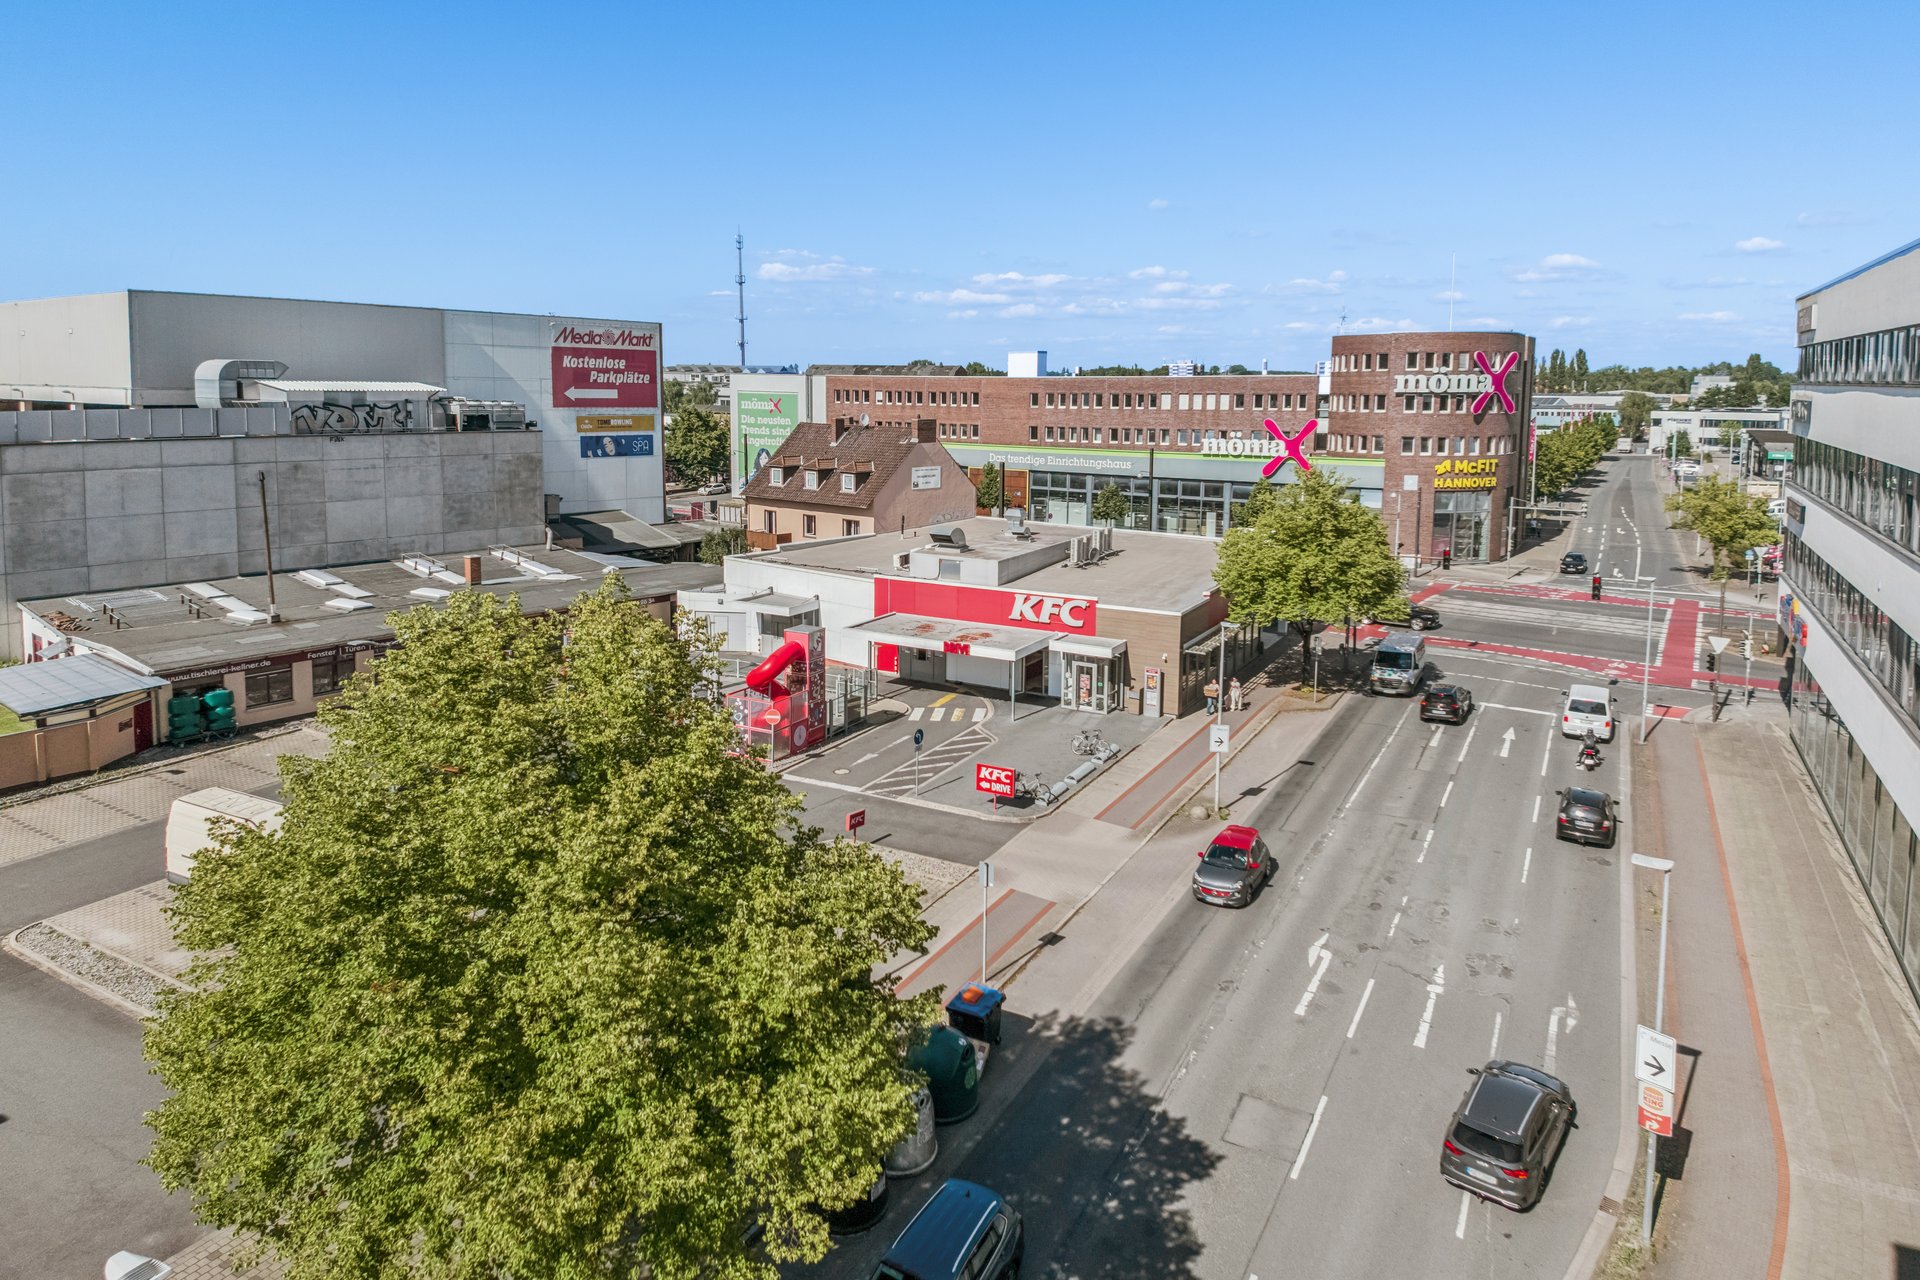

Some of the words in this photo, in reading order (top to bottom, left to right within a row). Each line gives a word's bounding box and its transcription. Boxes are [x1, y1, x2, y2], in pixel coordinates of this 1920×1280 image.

[562, 355, 626, 369] Kostenlose
[589, 370, 650, 386] Parkplätze
[741, 415, 755, 423] Die
[757, 415, 791, 425] neusten
[741, 425, 770, 435] Trends
[772, 427, 791, 436] sind
[632, 440, 650, 452] SPA
[989, 453, 1006, 462] Das
[1007, 454, 1045, 466] trendige
[1047, 457, 1132, 470] Einrichtungshaus
[1454, 459, 1498, 473] McFIT
[1434, 477, 1497, 489] HANNOVER
[1008, 594, 1090, 627] KFC
[307, 649, 337, 659] Fenster
[166, 660, 271, 682] www.tischlerei-kellner.de
[979, 766, 1012, 783] KFC
[991, 782, 1011, 794] DRIVE
